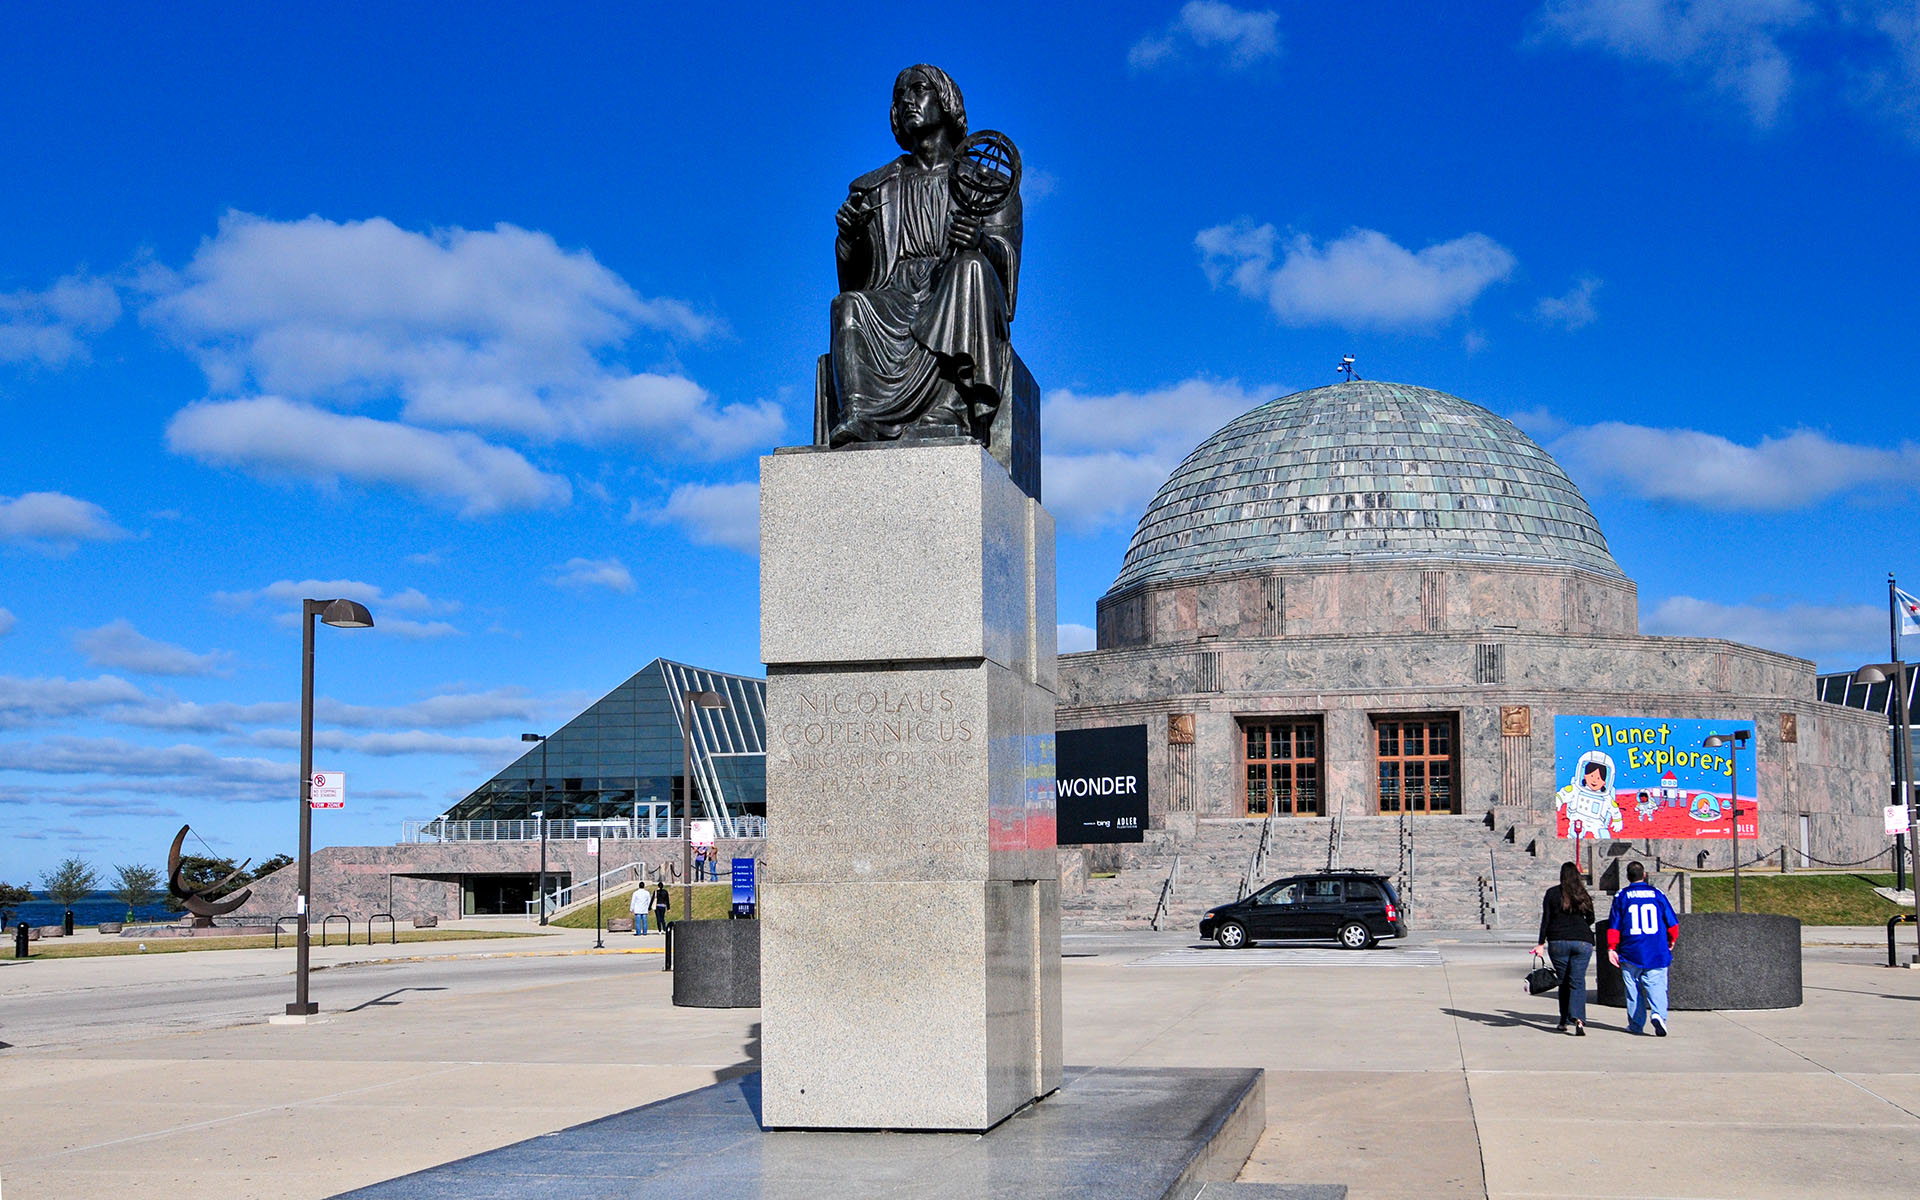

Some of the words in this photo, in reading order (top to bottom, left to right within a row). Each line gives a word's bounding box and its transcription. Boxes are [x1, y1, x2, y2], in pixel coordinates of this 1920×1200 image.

[800, 690, 954, 714] NICOLAUS
[1270, 694, 1325, 710] ADLER
[782, 720, 972, 745] COPERNICUS
[1591, 722, 1671, 747] Planet
[1627, 746, 1734, 776] Explorers
[1056, 775, 1137, 797] WONDER
[1116, 816, 1138, 826] ADLER
[1736, 824, 1754, 833] DLER
[1628, 903, 1659, 935] 10
